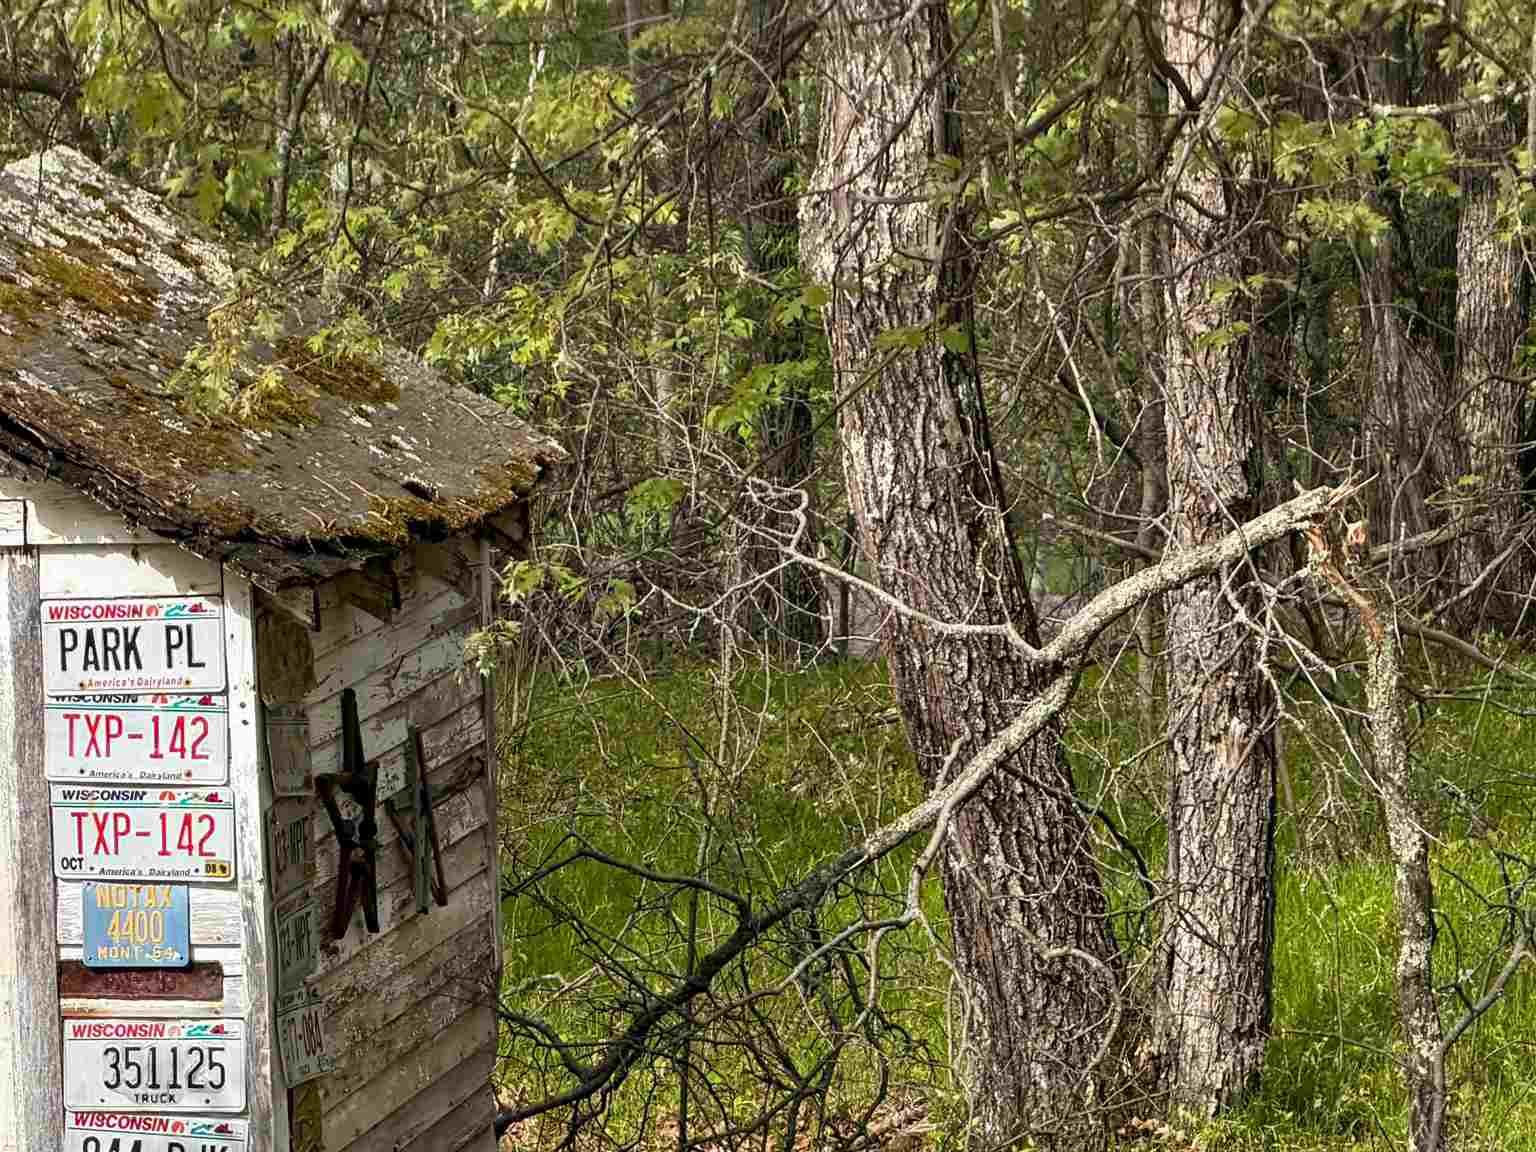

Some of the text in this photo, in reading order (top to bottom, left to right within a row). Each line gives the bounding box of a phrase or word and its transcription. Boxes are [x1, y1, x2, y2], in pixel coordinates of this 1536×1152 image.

[48, 604, 143, 620] WISCONSIN
[60, 624, 206, 671] PARK PL
[87, 677, 182, 688] America's Dairyland
[63, 713, 209, 759] TXP-142
[89, 769, 132, 779] America's
[62, 790, 145, 801] WISCONSIN
[71, 812, 216, 856] TXP-142
[61, 857, 84, 870] OCT
[99, 867, 143, 876] America's
[108, 910, 164, 945] 4400
[72, 1024, 163, 1038] WISCONSIN
[103, 1046, 226, 1090] 351125
[134, 1093, 176, 1104] TRUCK
[74, 1112, 168, 1132] WISCONSIN
